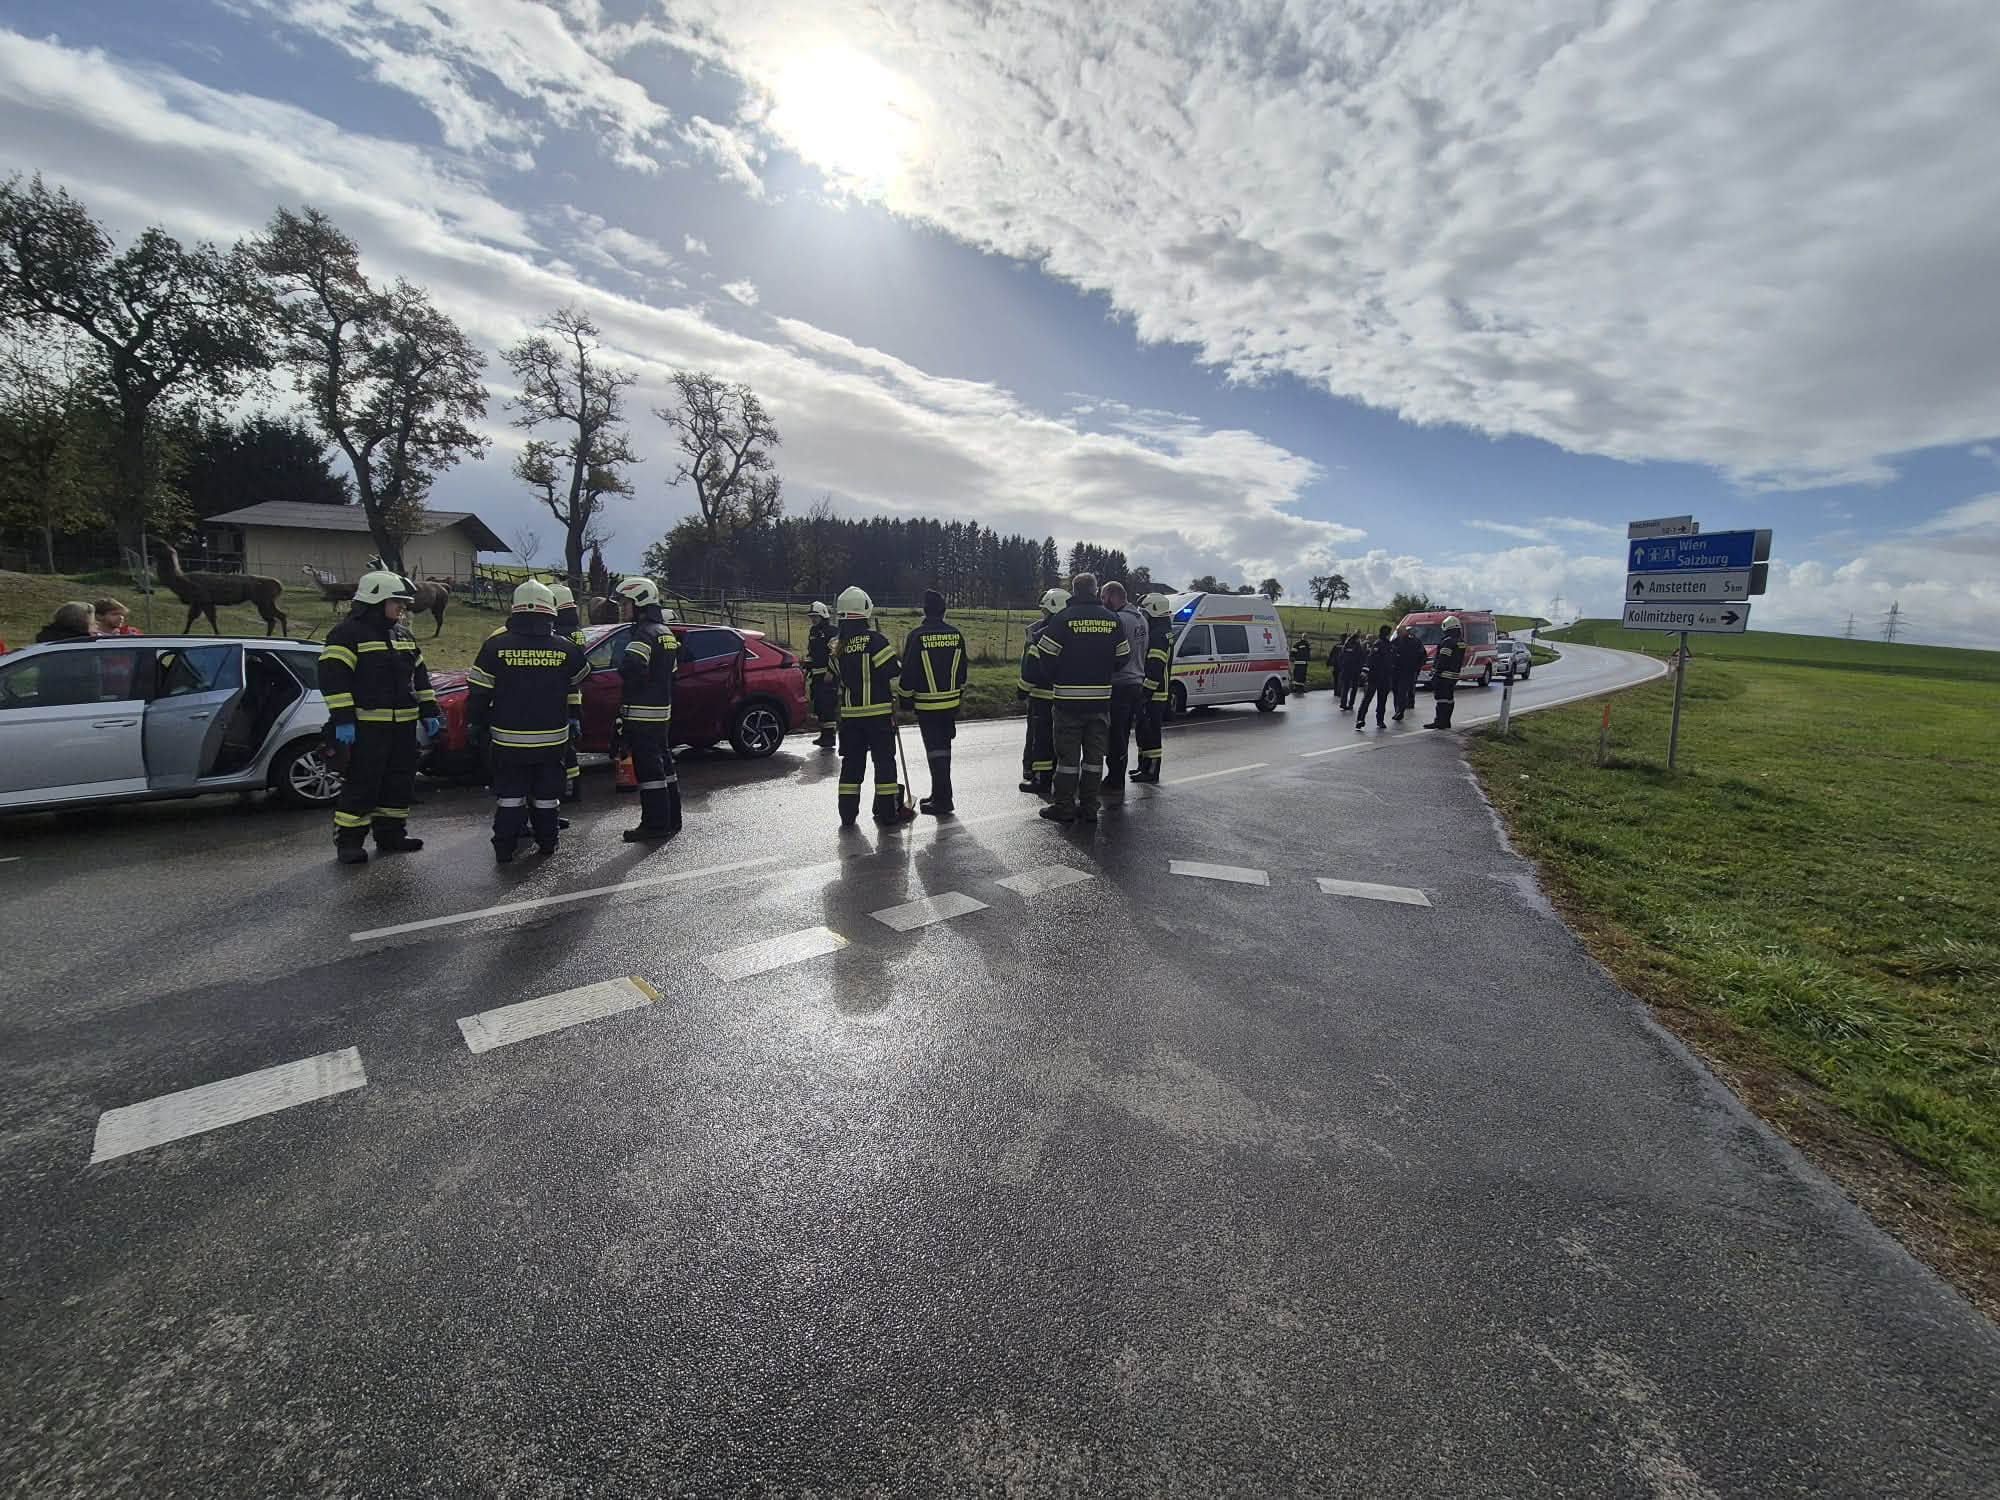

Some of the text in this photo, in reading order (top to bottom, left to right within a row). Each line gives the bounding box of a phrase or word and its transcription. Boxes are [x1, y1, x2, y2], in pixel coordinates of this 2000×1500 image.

[1679, 539, 1707, 551] Wien
[1677, 553, 1729, 567] Salzburg
[1649, 581, 1707, 593] Amstetten
[1723, 581, 1730, 593] 5
[1628, 609, 1695, 626] Kollmitzberg
[1699, 613, 1704, 624] 4
[1068, 619, 1117, 628] FEUERWEHR
[1073, 626, 1113, 634] VIEHDORF
[497, 649, 567, 660] FEUERWEHR
[504, 658, 562, 667] VIEHDORF
